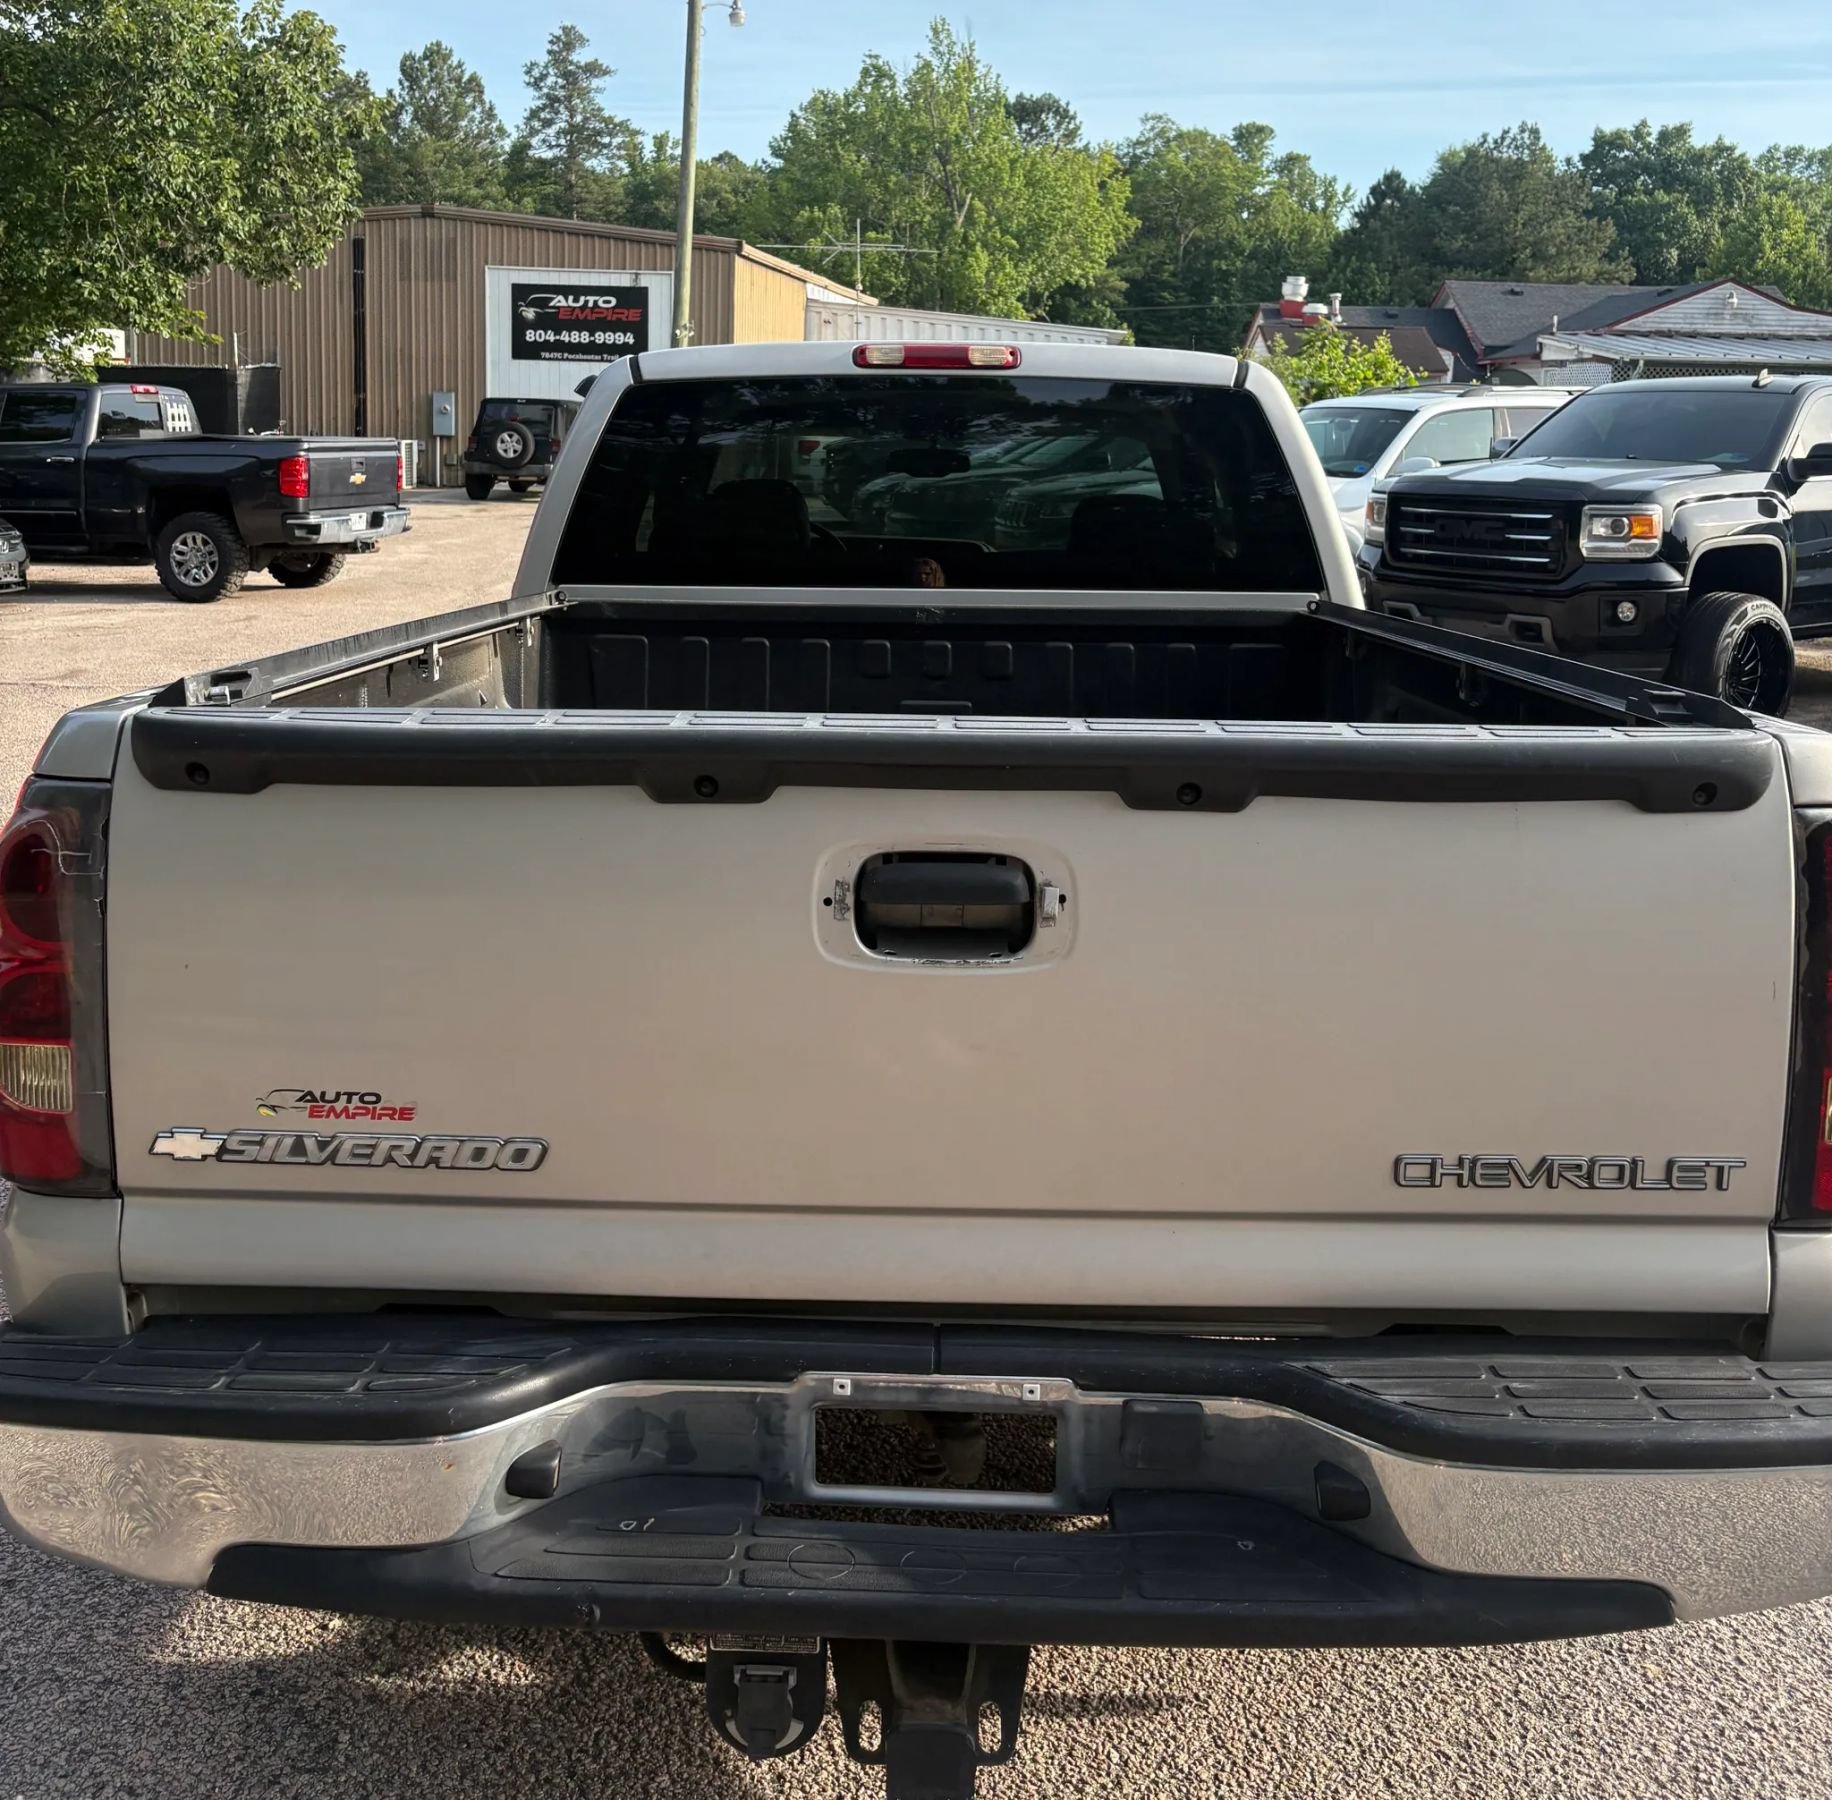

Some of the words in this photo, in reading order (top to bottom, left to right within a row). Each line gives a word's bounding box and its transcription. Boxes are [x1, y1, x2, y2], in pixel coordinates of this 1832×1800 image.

[549, 295, 617, 308] AUTO
[558, 308, 642, 322] EMPIRE
[525, 329, 635, 345] 804-488-9994
[295, 1090, 382, 1105] AUTO
[307, 1104, 416, 1121] EMPIRE
[216, 1130, 549, 1171] SILVERADO
[1394, 1154, 1747, 1191] CHEVROLET
